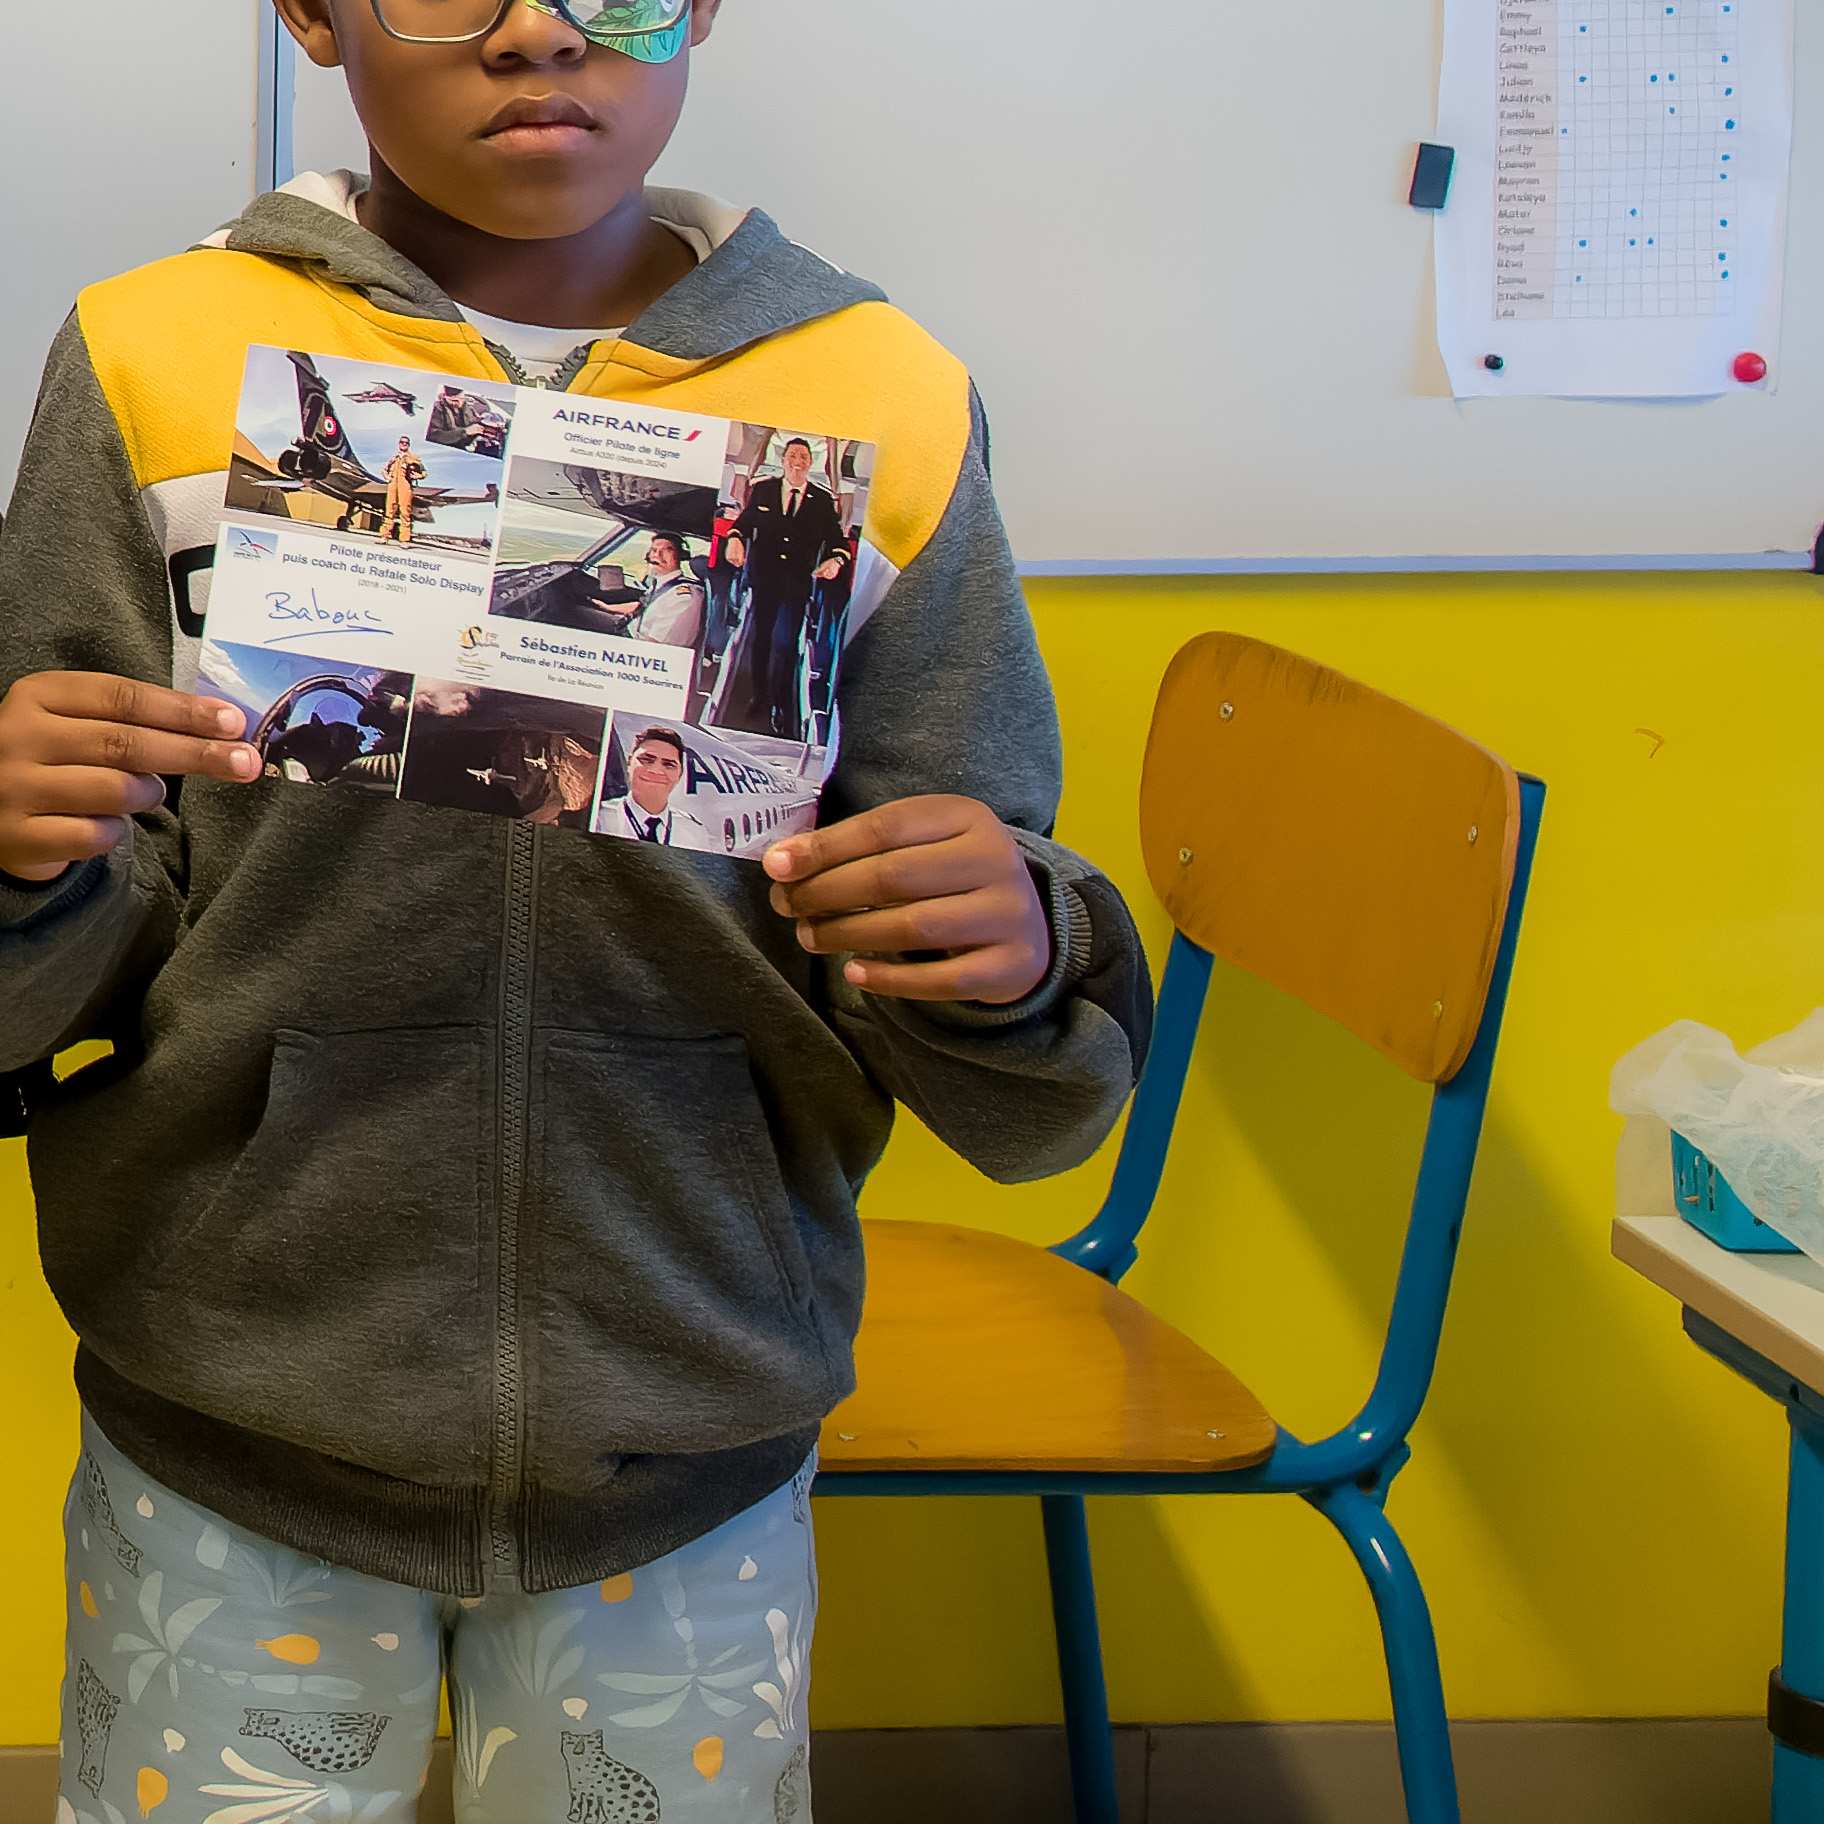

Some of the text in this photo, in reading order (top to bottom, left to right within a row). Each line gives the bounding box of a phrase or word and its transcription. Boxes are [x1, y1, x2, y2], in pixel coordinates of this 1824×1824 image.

[552, 409, 681, 440] AIRFRANCE
[605, 439, 635, 452] Pilote
[638, 445, 652, 455] de
[654, 445, 681, 459] ligne
[329, 543, 443, 572] Pilote présentateur
[282, 552, 308, 565] puis
[311, 556, 348, 570] coach
[350, 562, 366, 574] du
[368, 566, 407, 582] Rafale
[409, 573, 438, 587] Solo
[440, 577, 485, 596] Display
[500, 651, 536, 665] Parrain
[538, 657, 551, 668] de
[553, 660, 614, 678] l'Association
[617, 671, 640, 683] 1000
[520, 636, 597, 660] Sébastien
[601, 650, 668, 673] NATIVEL
